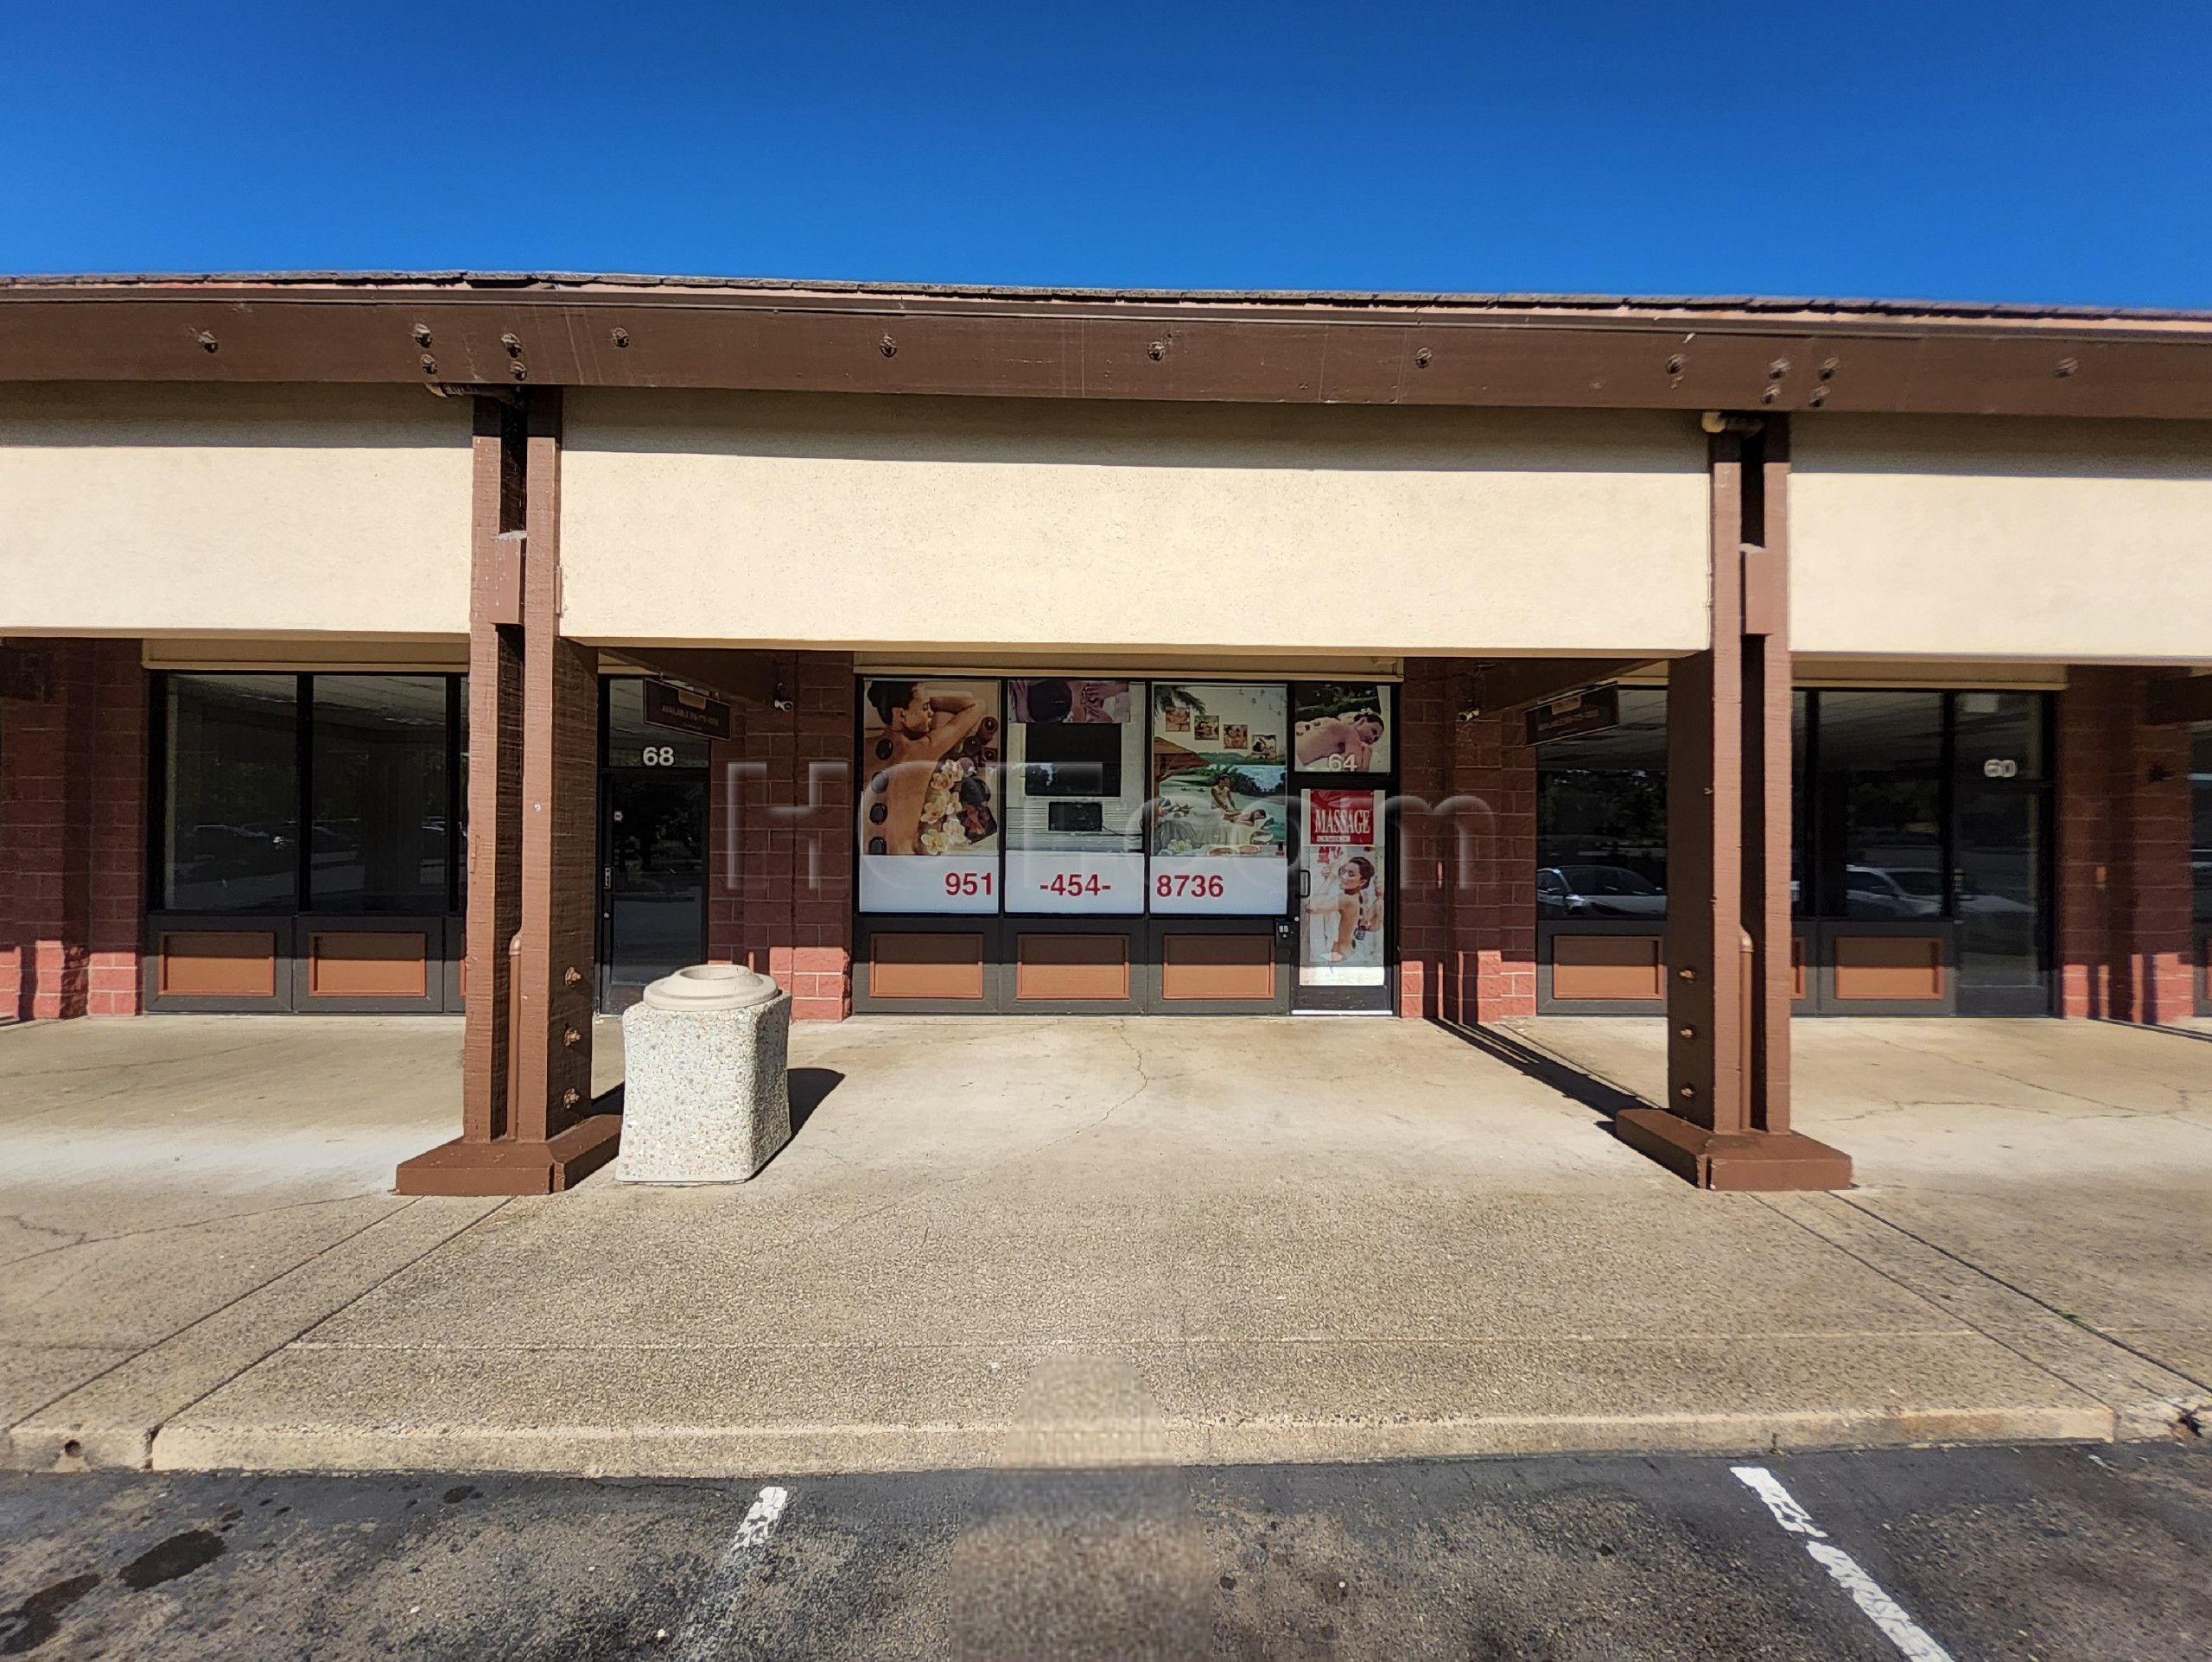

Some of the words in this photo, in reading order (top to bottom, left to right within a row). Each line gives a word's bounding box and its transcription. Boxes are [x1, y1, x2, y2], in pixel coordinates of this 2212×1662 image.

[643, 746, 675, 767] 68
[1328, 753, 1357, 772] 64
[1314, 809, 1370, 835] MASSAGE
[944, 872, 993, 896] 951
[1039, 873, 1111, 897] -454-
[1155, 875, 1224, 898] 8736
